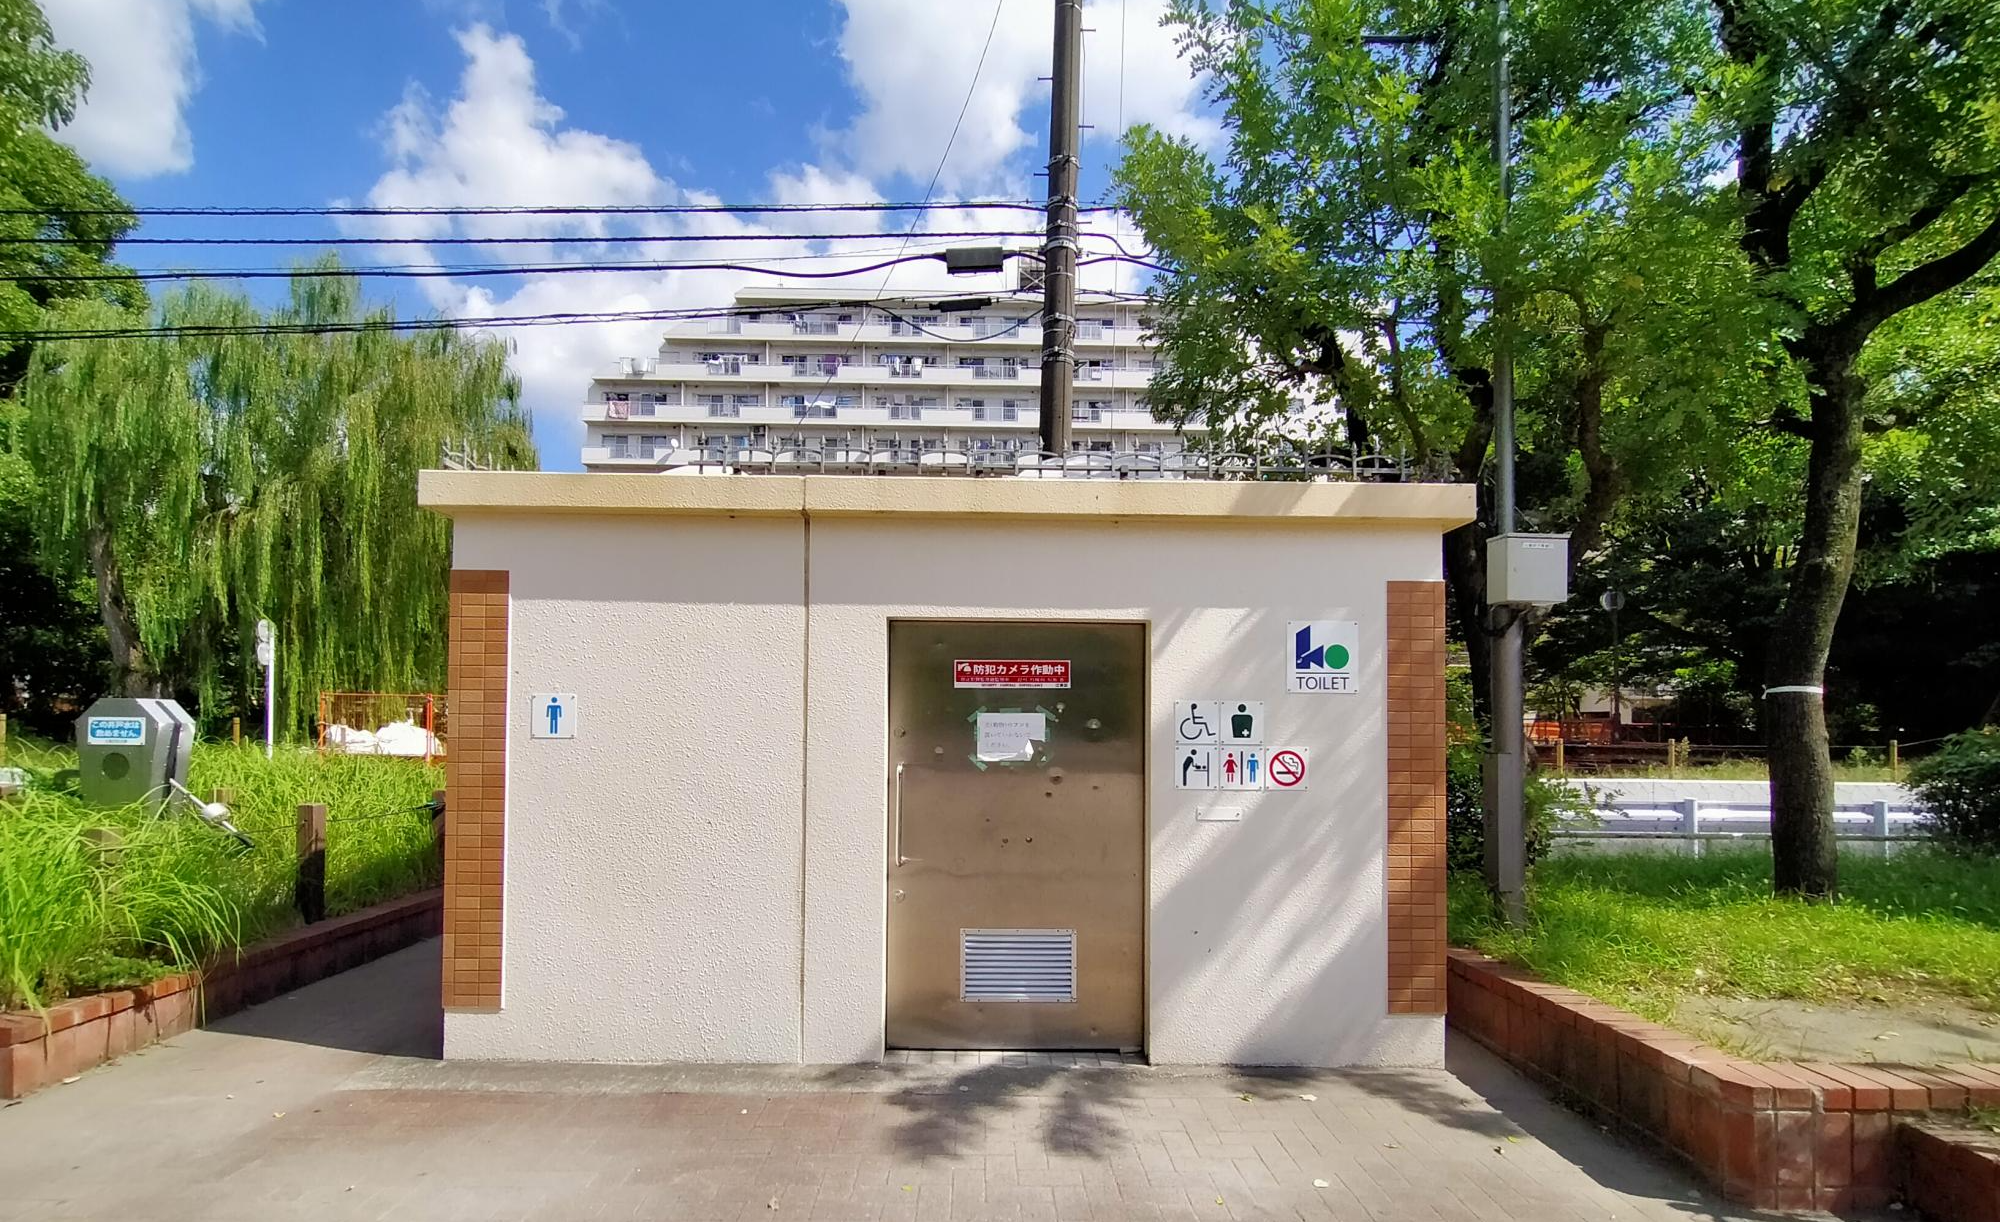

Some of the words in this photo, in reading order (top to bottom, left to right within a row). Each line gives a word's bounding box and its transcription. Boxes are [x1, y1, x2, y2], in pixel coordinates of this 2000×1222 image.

[973, 664, 1065, 675] 防犯カメラ作動中
[1296, 676, 1350, 690] TOILET
